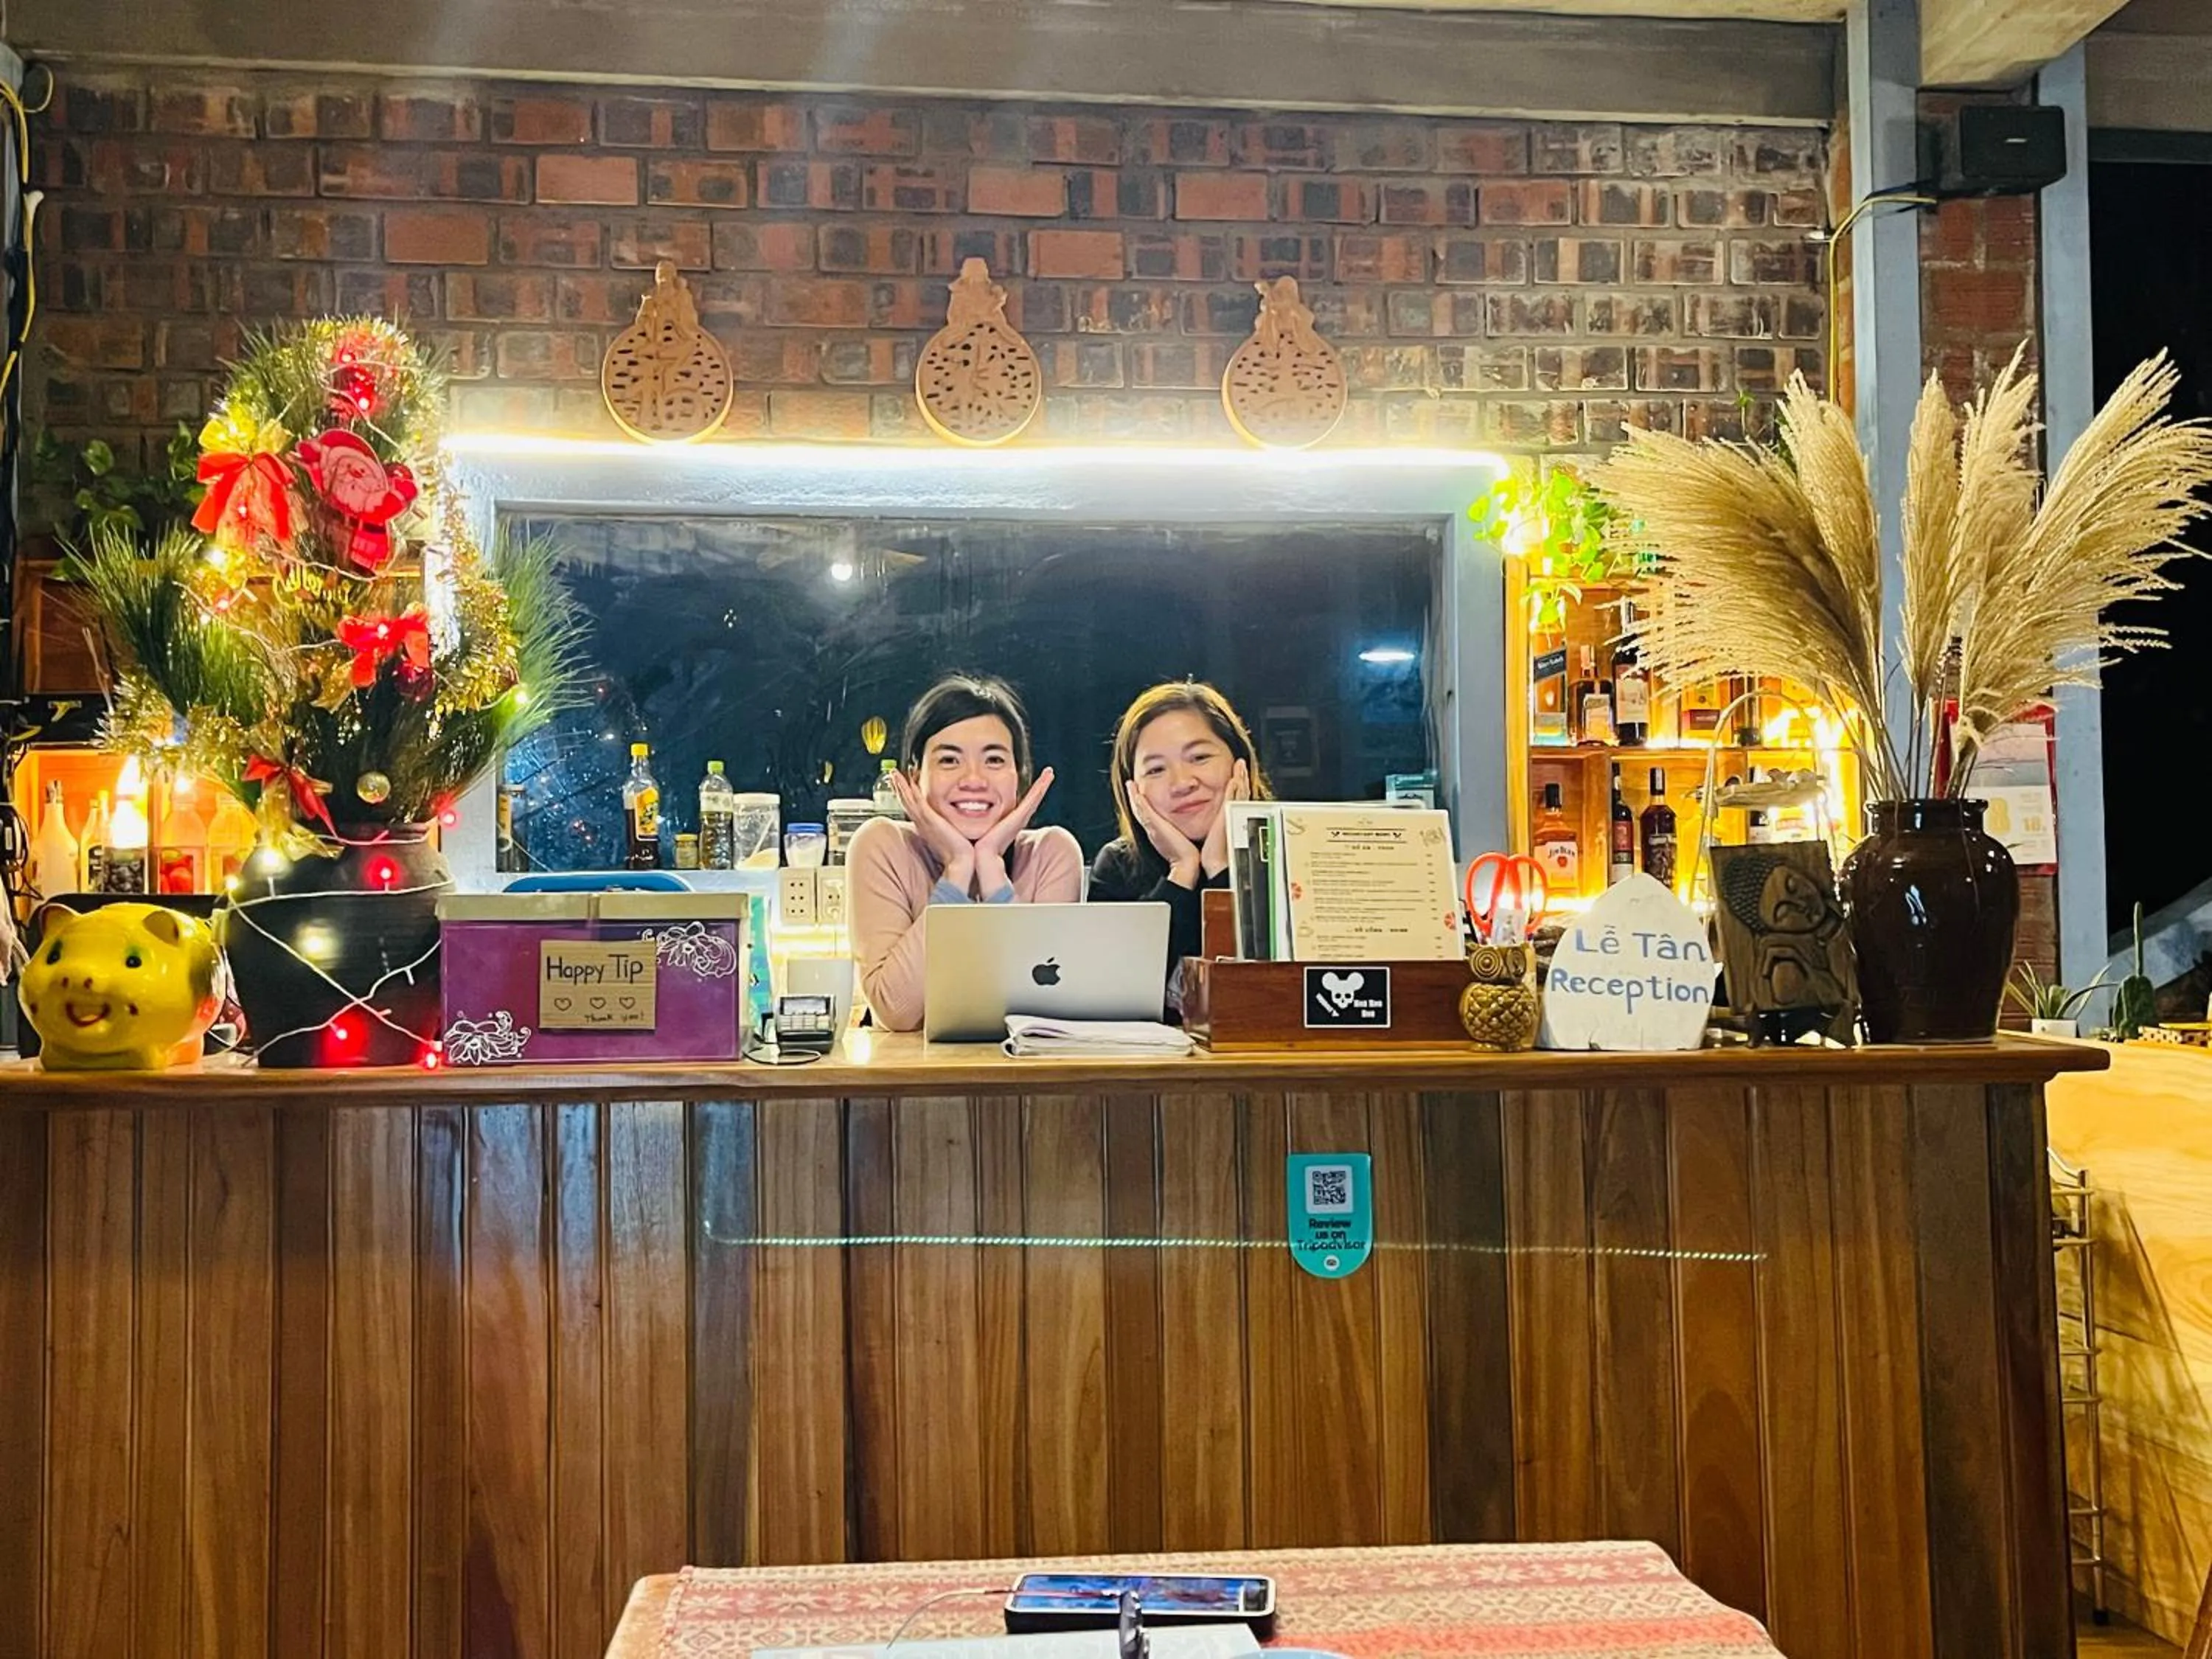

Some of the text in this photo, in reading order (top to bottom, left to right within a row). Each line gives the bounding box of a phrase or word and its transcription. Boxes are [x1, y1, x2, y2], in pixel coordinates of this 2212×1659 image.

[1575, 924, 1708, 962] Lễ Tân
[546, 954, 644, 985] Happy Tip
[1550, 967, 1709, 1014] Reception
[1308, 1217, 1352, 1229] Review
[1315, 1231, 1346, 1239] us on
